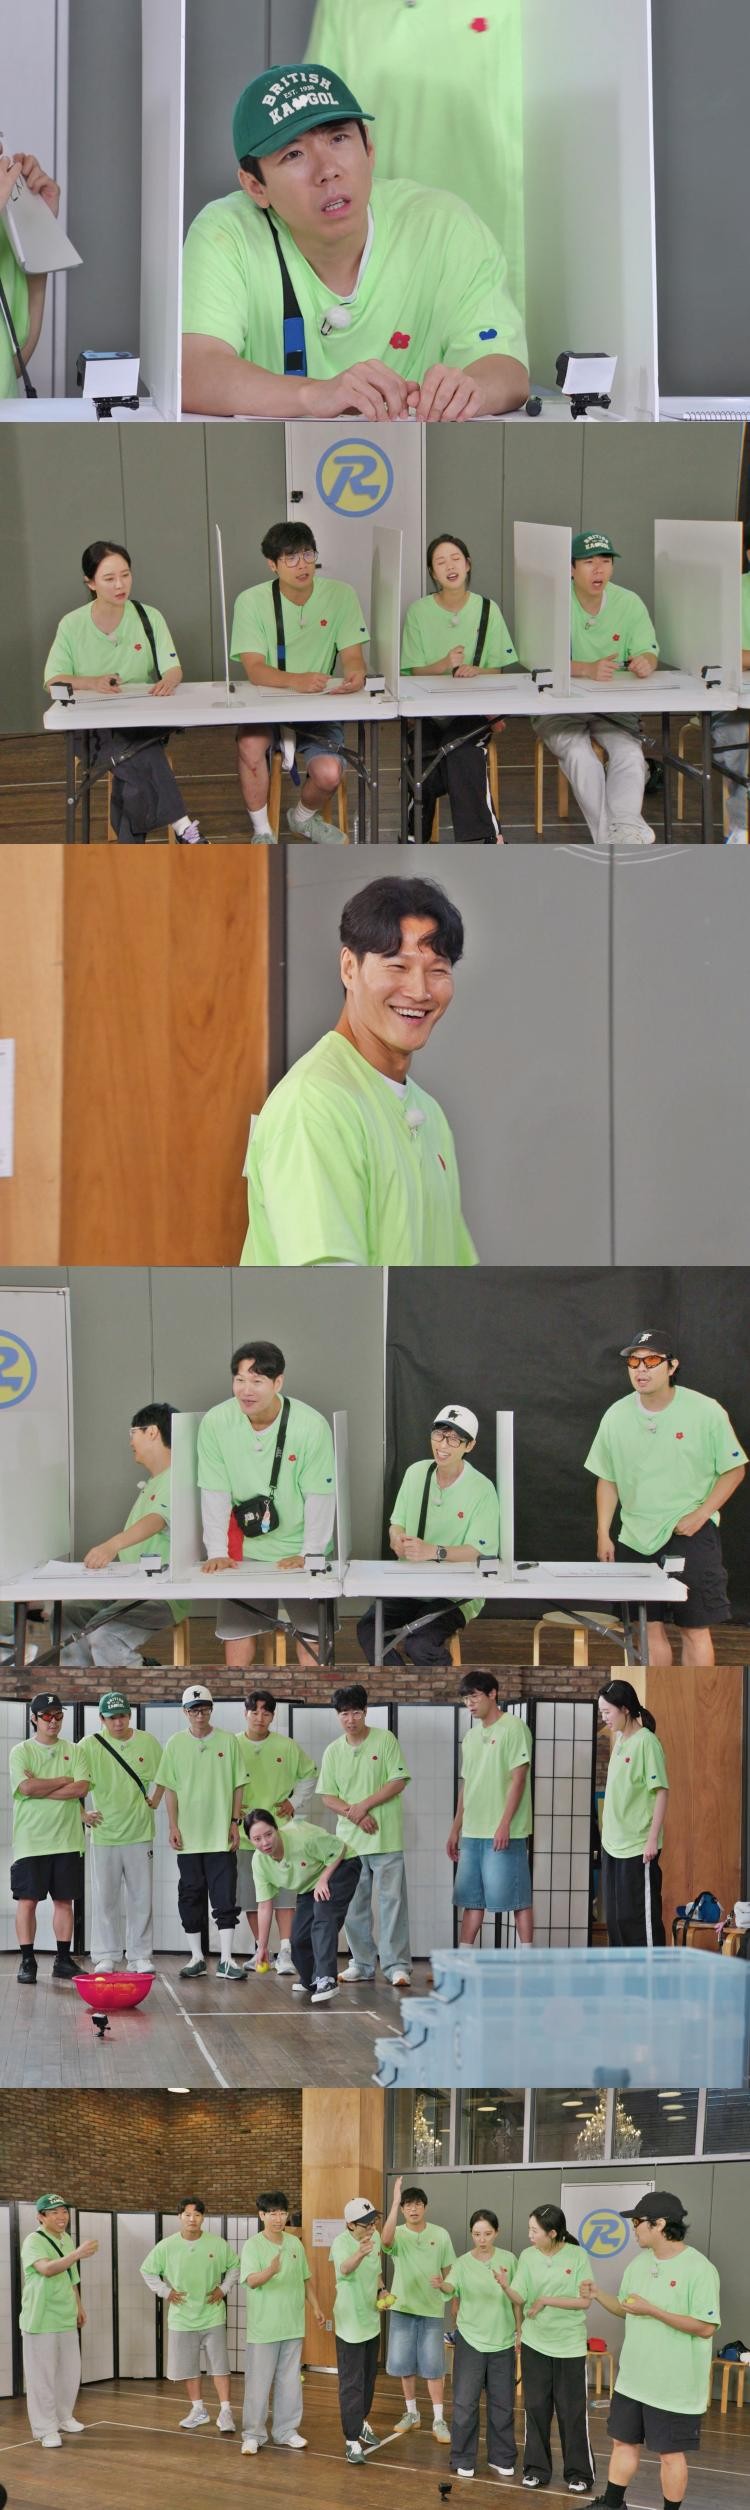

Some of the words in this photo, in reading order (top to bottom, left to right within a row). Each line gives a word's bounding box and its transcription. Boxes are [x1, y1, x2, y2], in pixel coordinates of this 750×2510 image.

[262, 73, 332, 107] BRITISH
[283, 89, 299, 99] EST.
[268, 92, 339, 125] KAGOL
